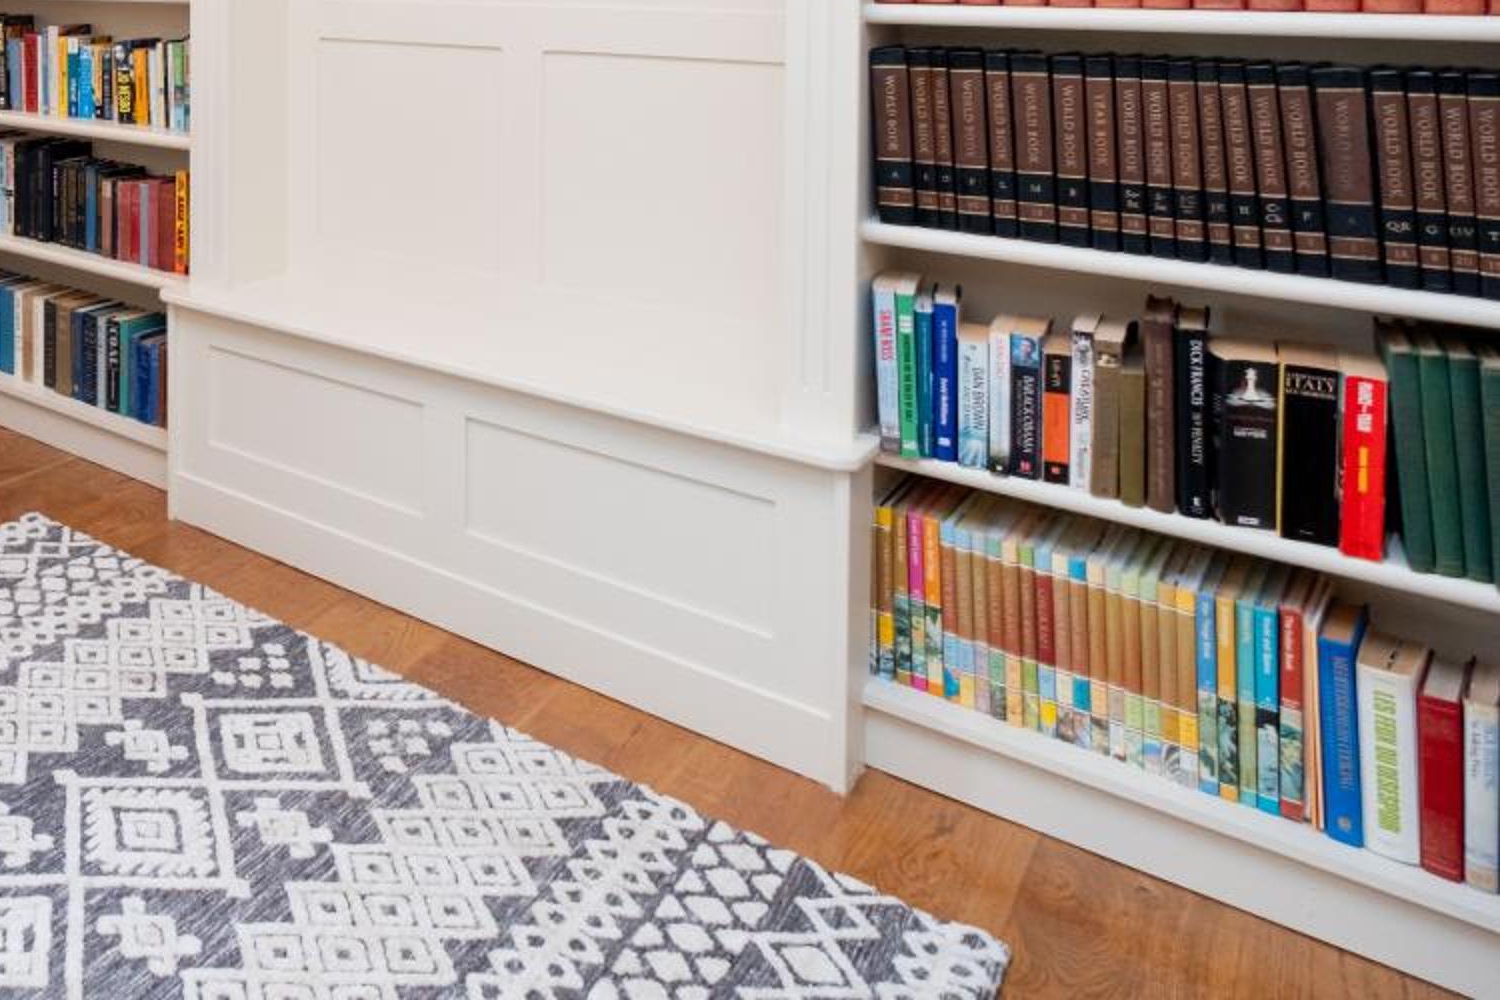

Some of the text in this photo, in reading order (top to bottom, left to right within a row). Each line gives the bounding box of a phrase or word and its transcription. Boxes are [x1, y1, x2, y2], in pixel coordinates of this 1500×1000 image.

[885, 75, 898, 117] WORLD
[915, 77, 927, 119] WORLD
[961, 80, 973, 123] WORLD
[992, 82, 1006, 162] WORLD BOOK
[1025, 84, 1039, 164] WORLD BOOK
[1061, 85, 1076, 169] WORLD BOOK
[1093, 94, 1108, 166] YEAR BOOK
[1123, 89, 1138, 172] WORLD BOOK
[1149, 91, 1165, 176] WORLD BOOK
[1175, 91, 1192, 178] WORLD BOOK
[1203, 94, 1219, 181] WORLD BOOK
[1226, 95, 1246, 185] WORLD BOOK
[1254, 96, 1275, 186] WORLD BOOK
[1288, 98, 1309, 189] WORLD BOOK
[1382, 103, 1403, 199] WORLD BOOK
[1415, 105, 1437, 201] WORLD BOOK
[1445, 107, 1467, 204] WORLD BOOK
[1478, 109, 1499, 207] WORLD BOOK
[971, 367, 985, 430] DAN BROWN
[1189, 340, 1204, 405] DICK FRANCIS
[1022, 376, 1035, 453] BARACK OBAMA
[1190, 427, 1203, 465] PENALTY
[1373, 689, 1397, 713] LES
[1376, 746, 1398, 765] DU
